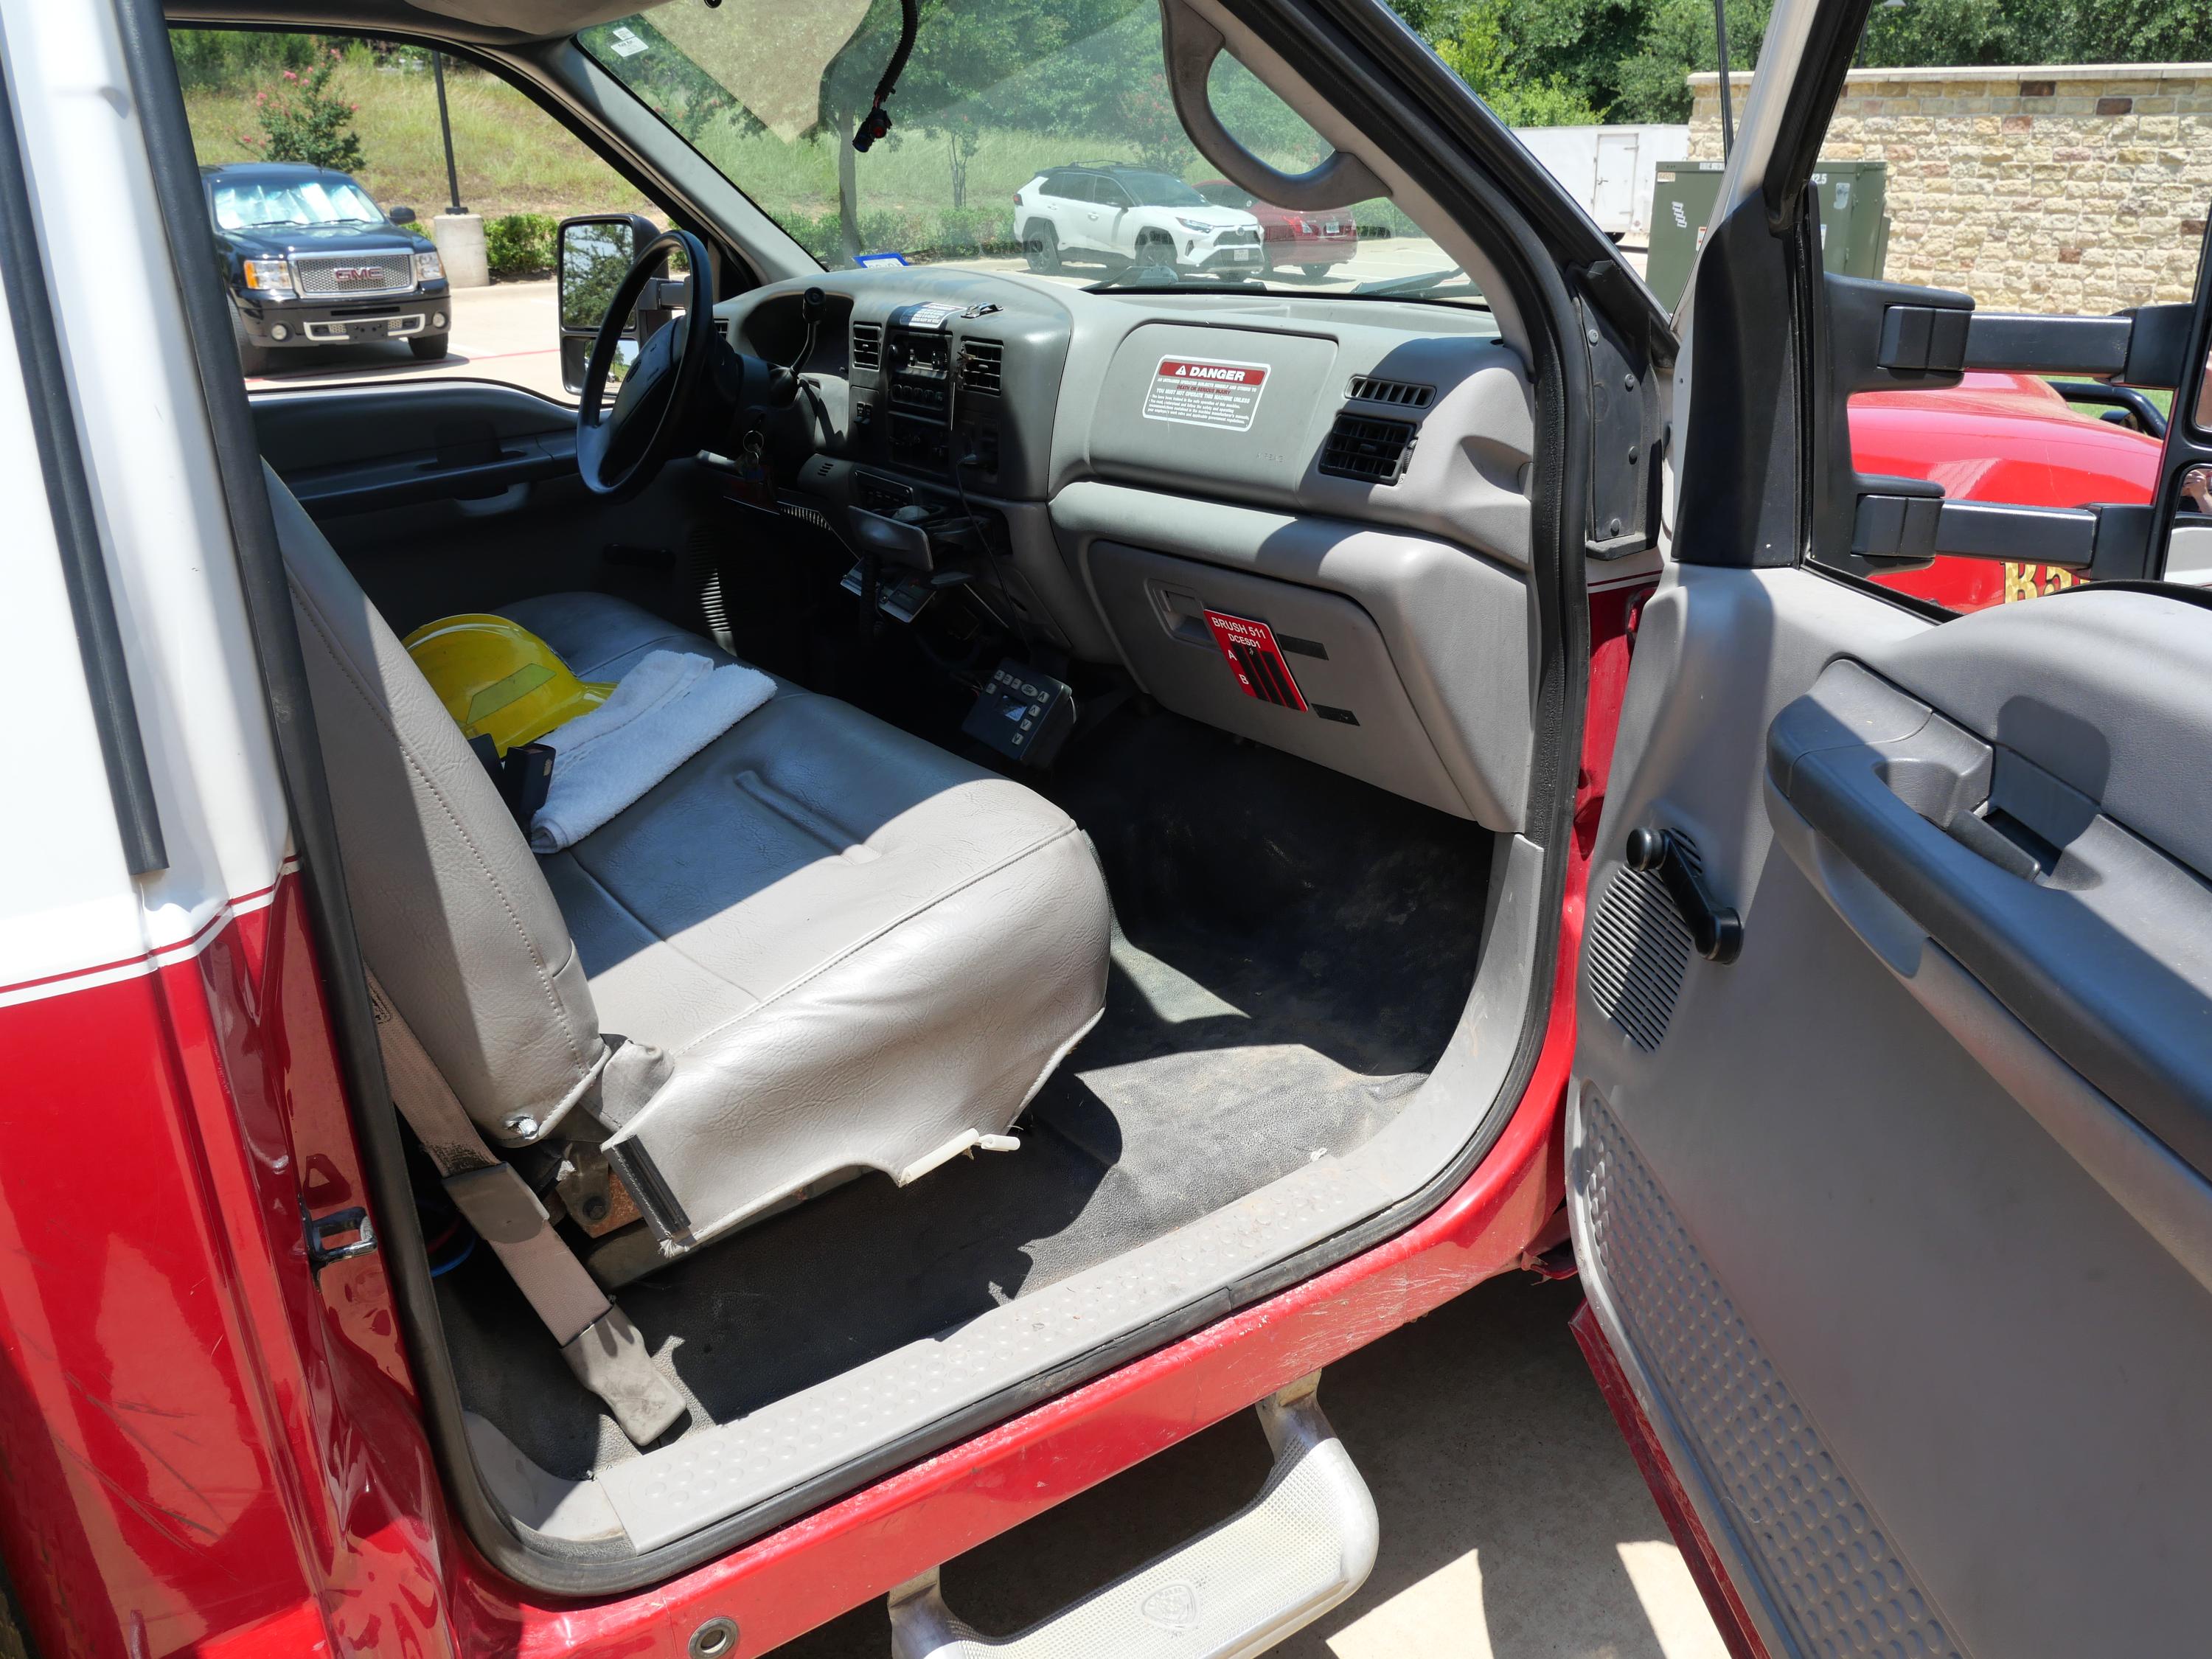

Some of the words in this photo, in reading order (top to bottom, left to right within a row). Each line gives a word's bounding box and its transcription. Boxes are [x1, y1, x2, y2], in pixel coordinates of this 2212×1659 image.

[333, 267, 384, 281] GMC
[1189, 366, 1245, 381] DANGER
[1211, 616, 1247, 635] BRUSH
[1248, 627, 1267, 639] 511
[1228, 633, 1261, 649] DCESD1
[1228, 650, 1237, 661] A
[1239, 674, 1249, 685] B
